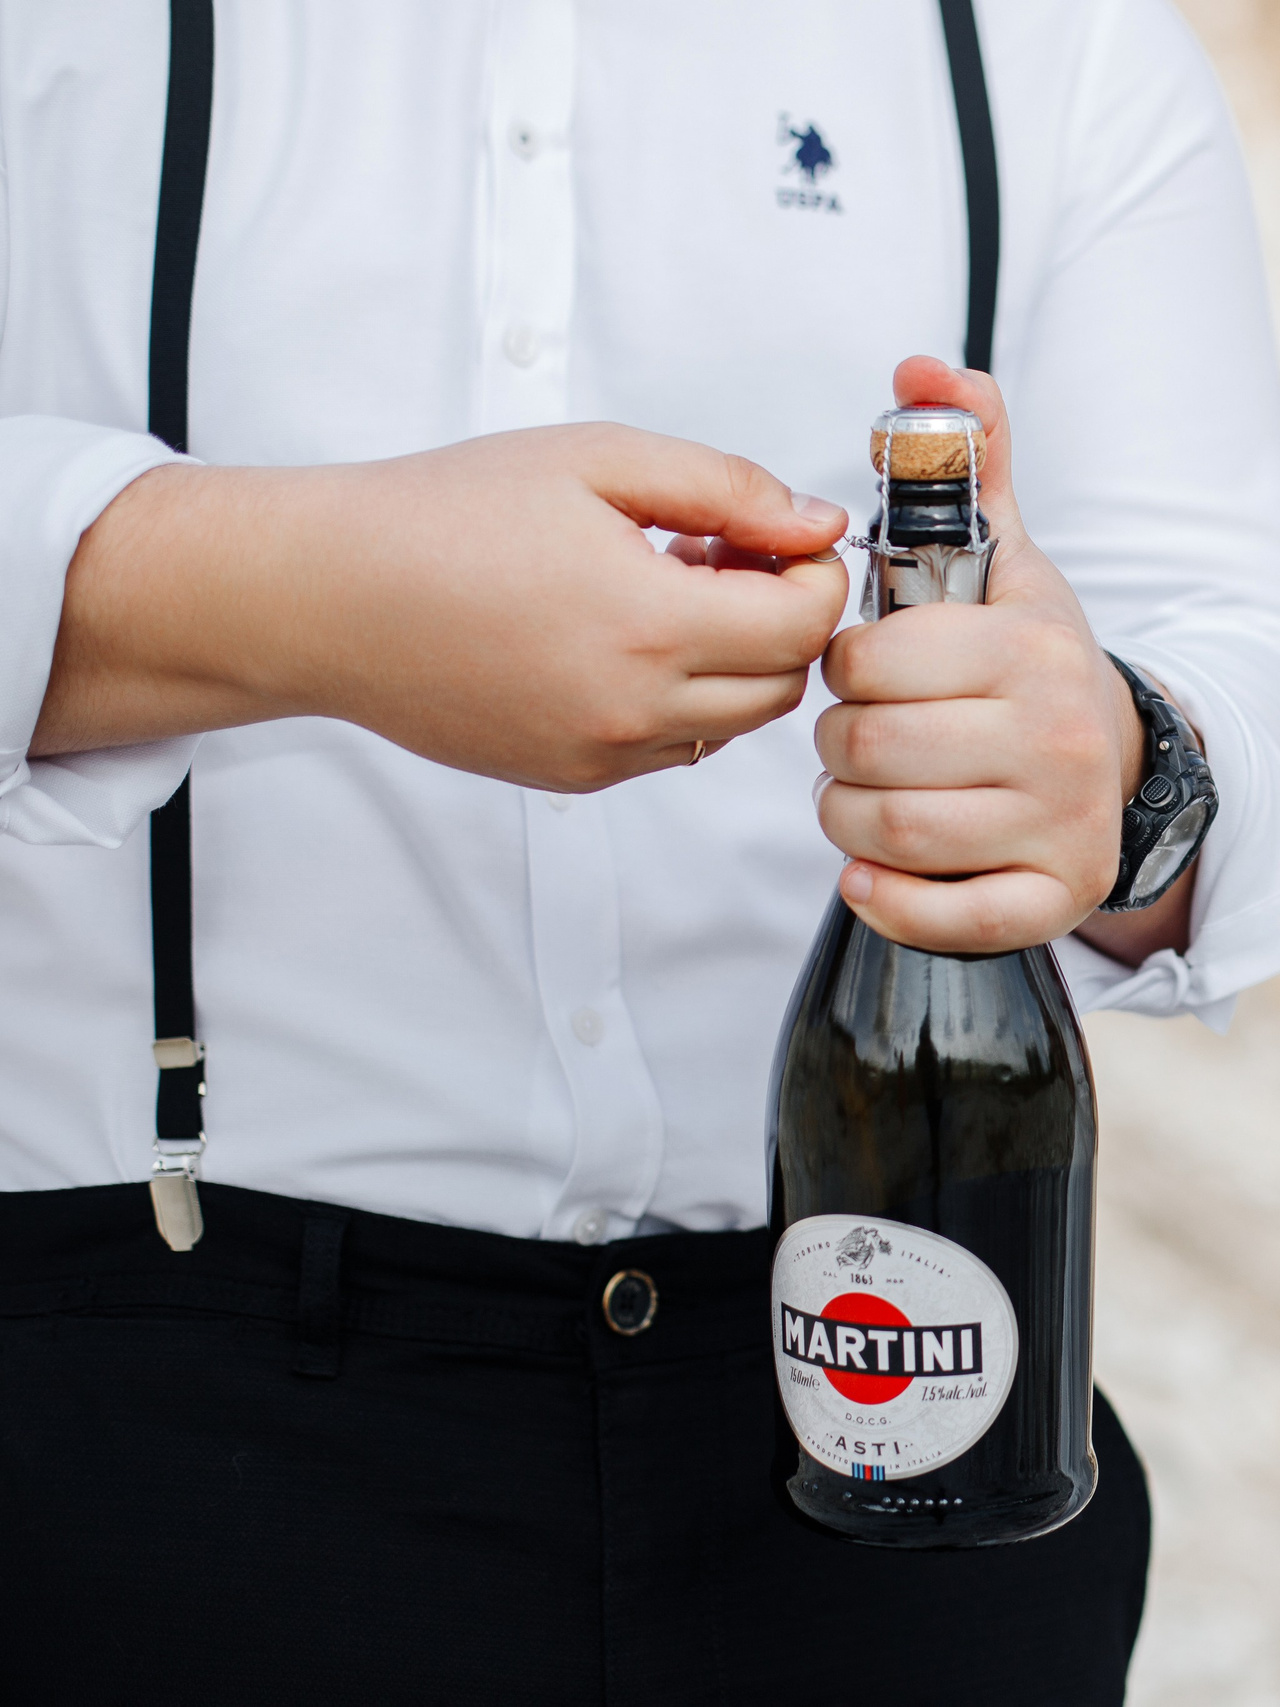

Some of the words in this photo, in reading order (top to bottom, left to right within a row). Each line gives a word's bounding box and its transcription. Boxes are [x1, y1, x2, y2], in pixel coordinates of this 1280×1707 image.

[850, 1273, 874, 1285] 1863
[784, 1310, 974, 1373] MARTINI
[835, 1435, 901, 1456] ASTI
